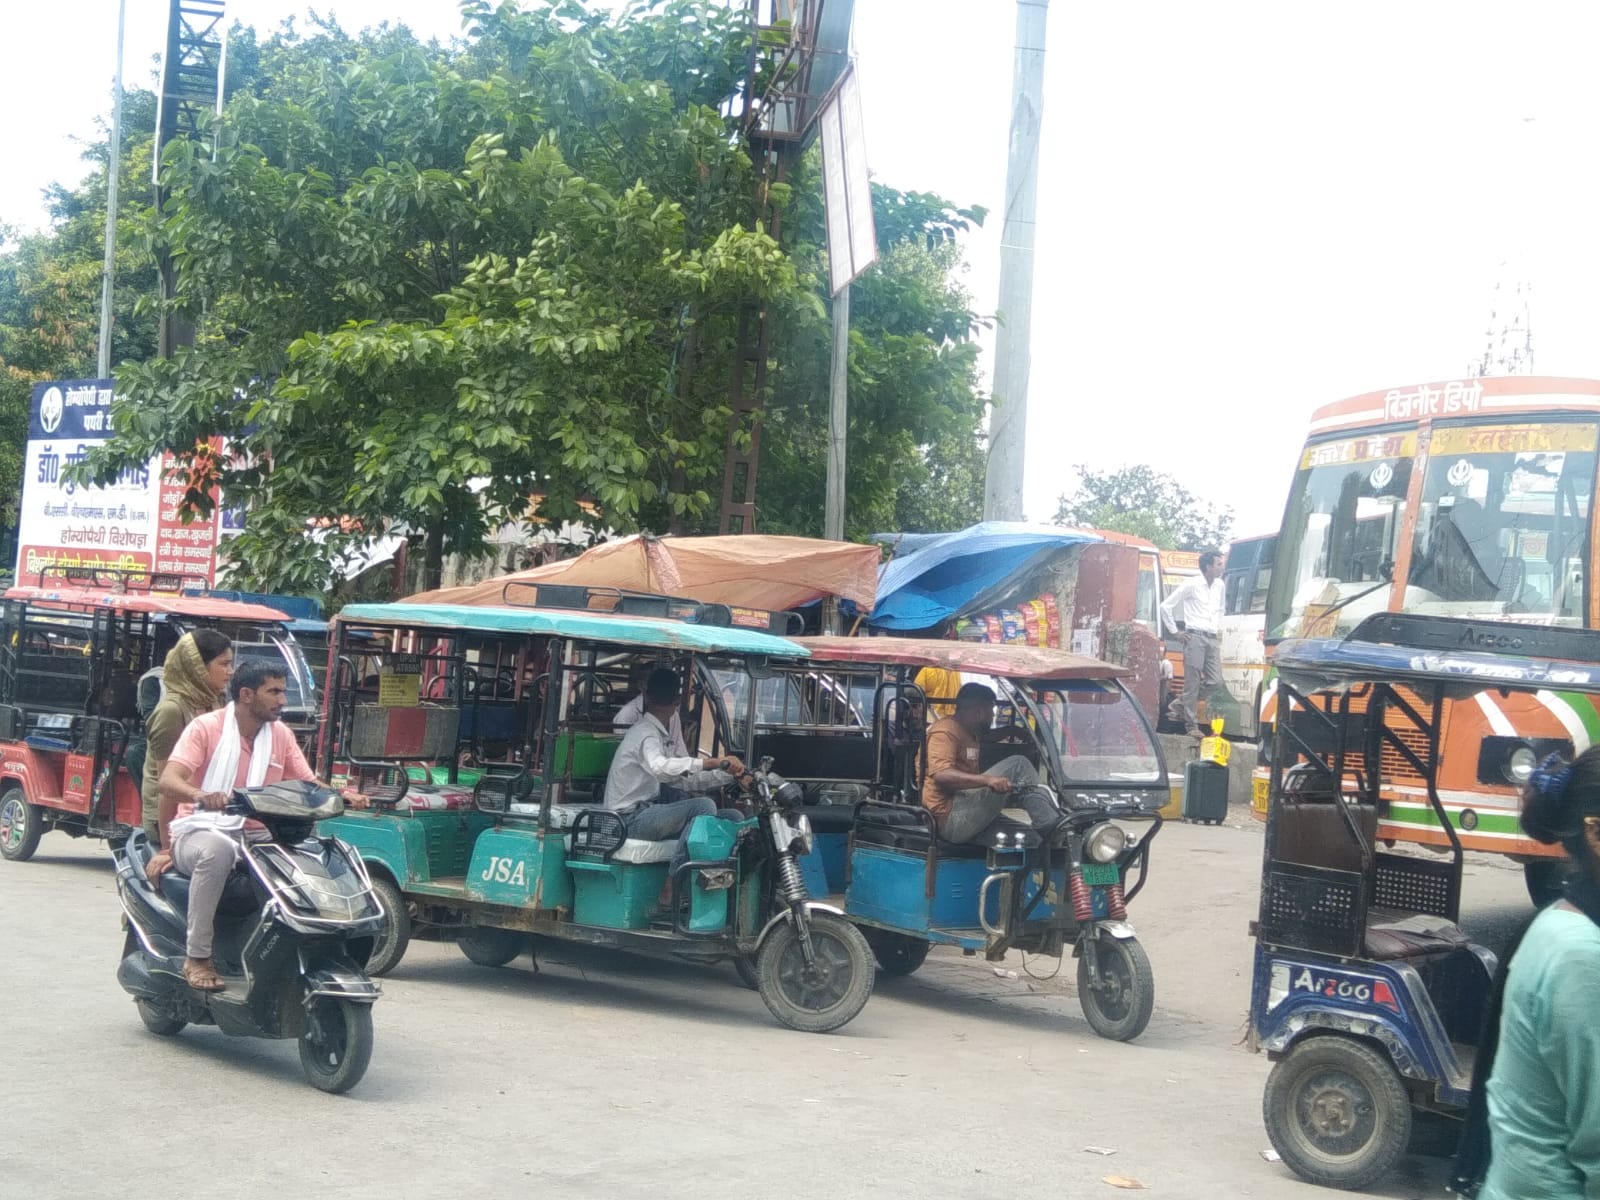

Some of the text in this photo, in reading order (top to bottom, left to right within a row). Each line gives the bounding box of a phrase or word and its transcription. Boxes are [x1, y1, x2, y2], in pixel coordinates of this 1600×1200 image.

[1384, 380, 1483, 420] बिजनौर डिपो
[61, 525, 148, 549] होम्योपैथी विशेषज्ञ
[482, 856, 525, 885] JSA
